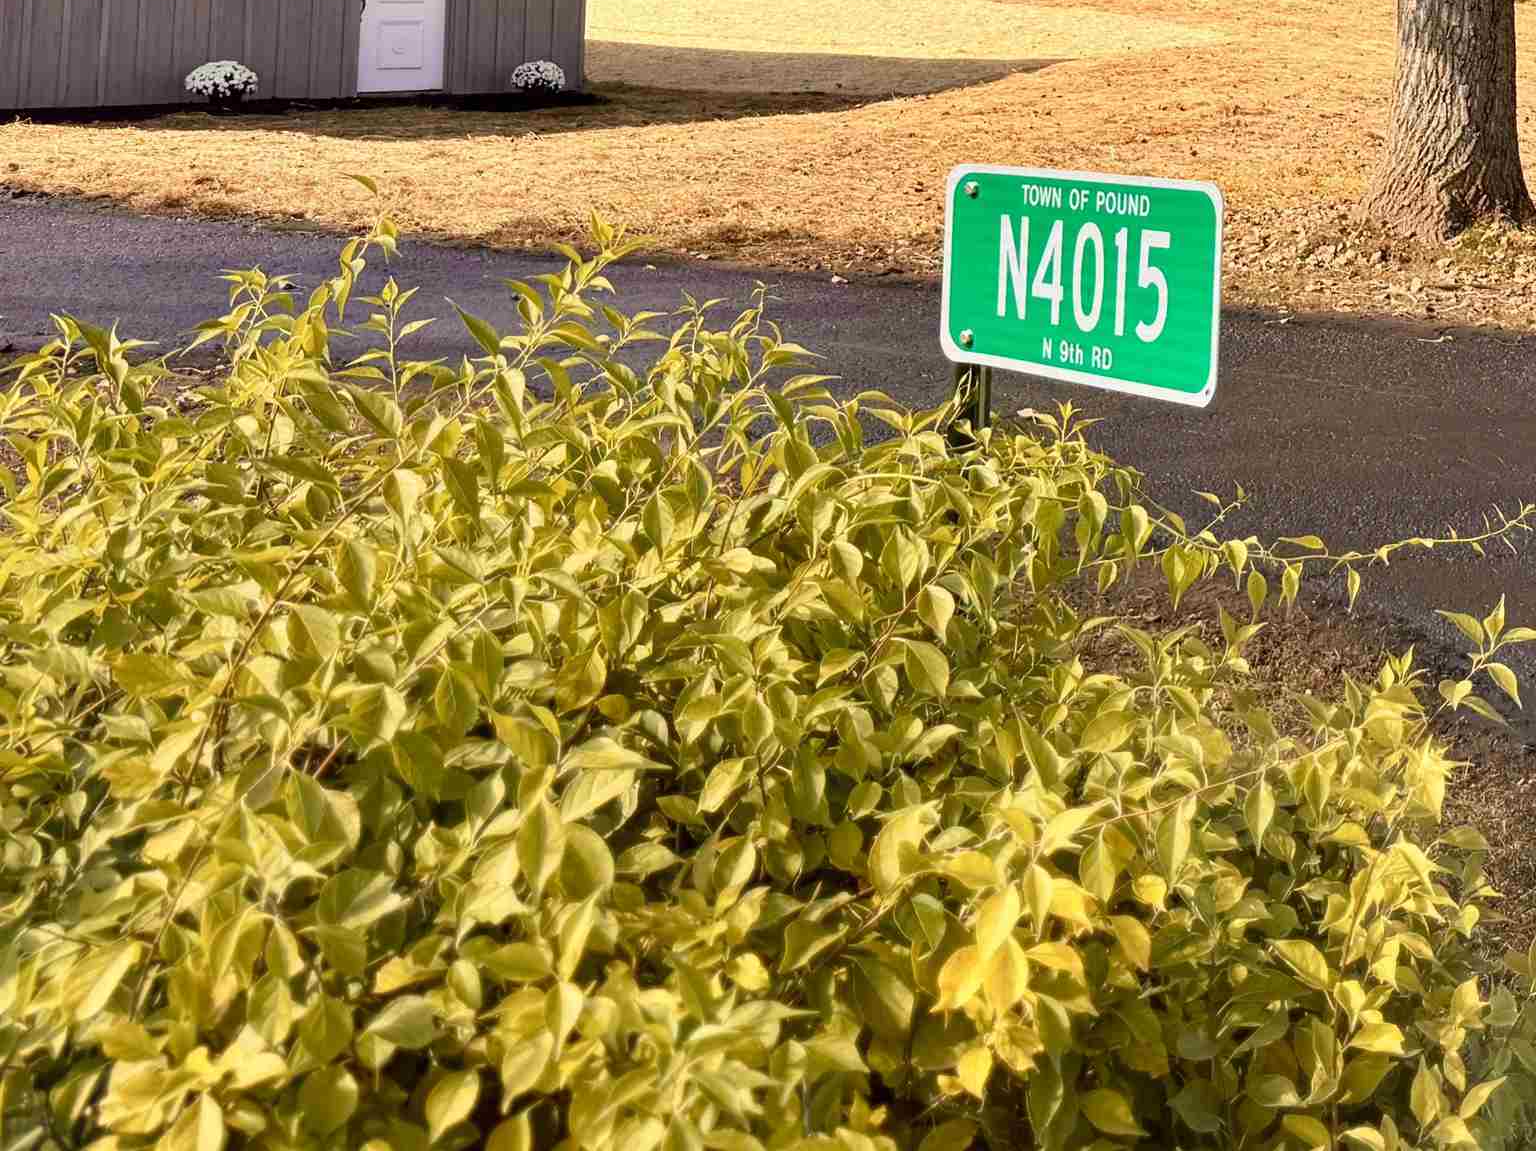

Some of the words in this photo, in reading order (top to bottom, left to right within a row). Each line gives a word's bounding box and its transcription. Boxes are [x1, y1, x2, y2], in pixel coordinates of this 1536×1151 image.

[1022, 184, 1062, 209] TOWN
[1069, 188, 1089, 211] OF
[1096, 191, 1150, 217] POUND
[997, 214, 1171, 343] N4015
[1042, 338, 1052, 359] N
[1059, 340, 1084, 365] 9th
[1092, 346, 1112, 370] RD
